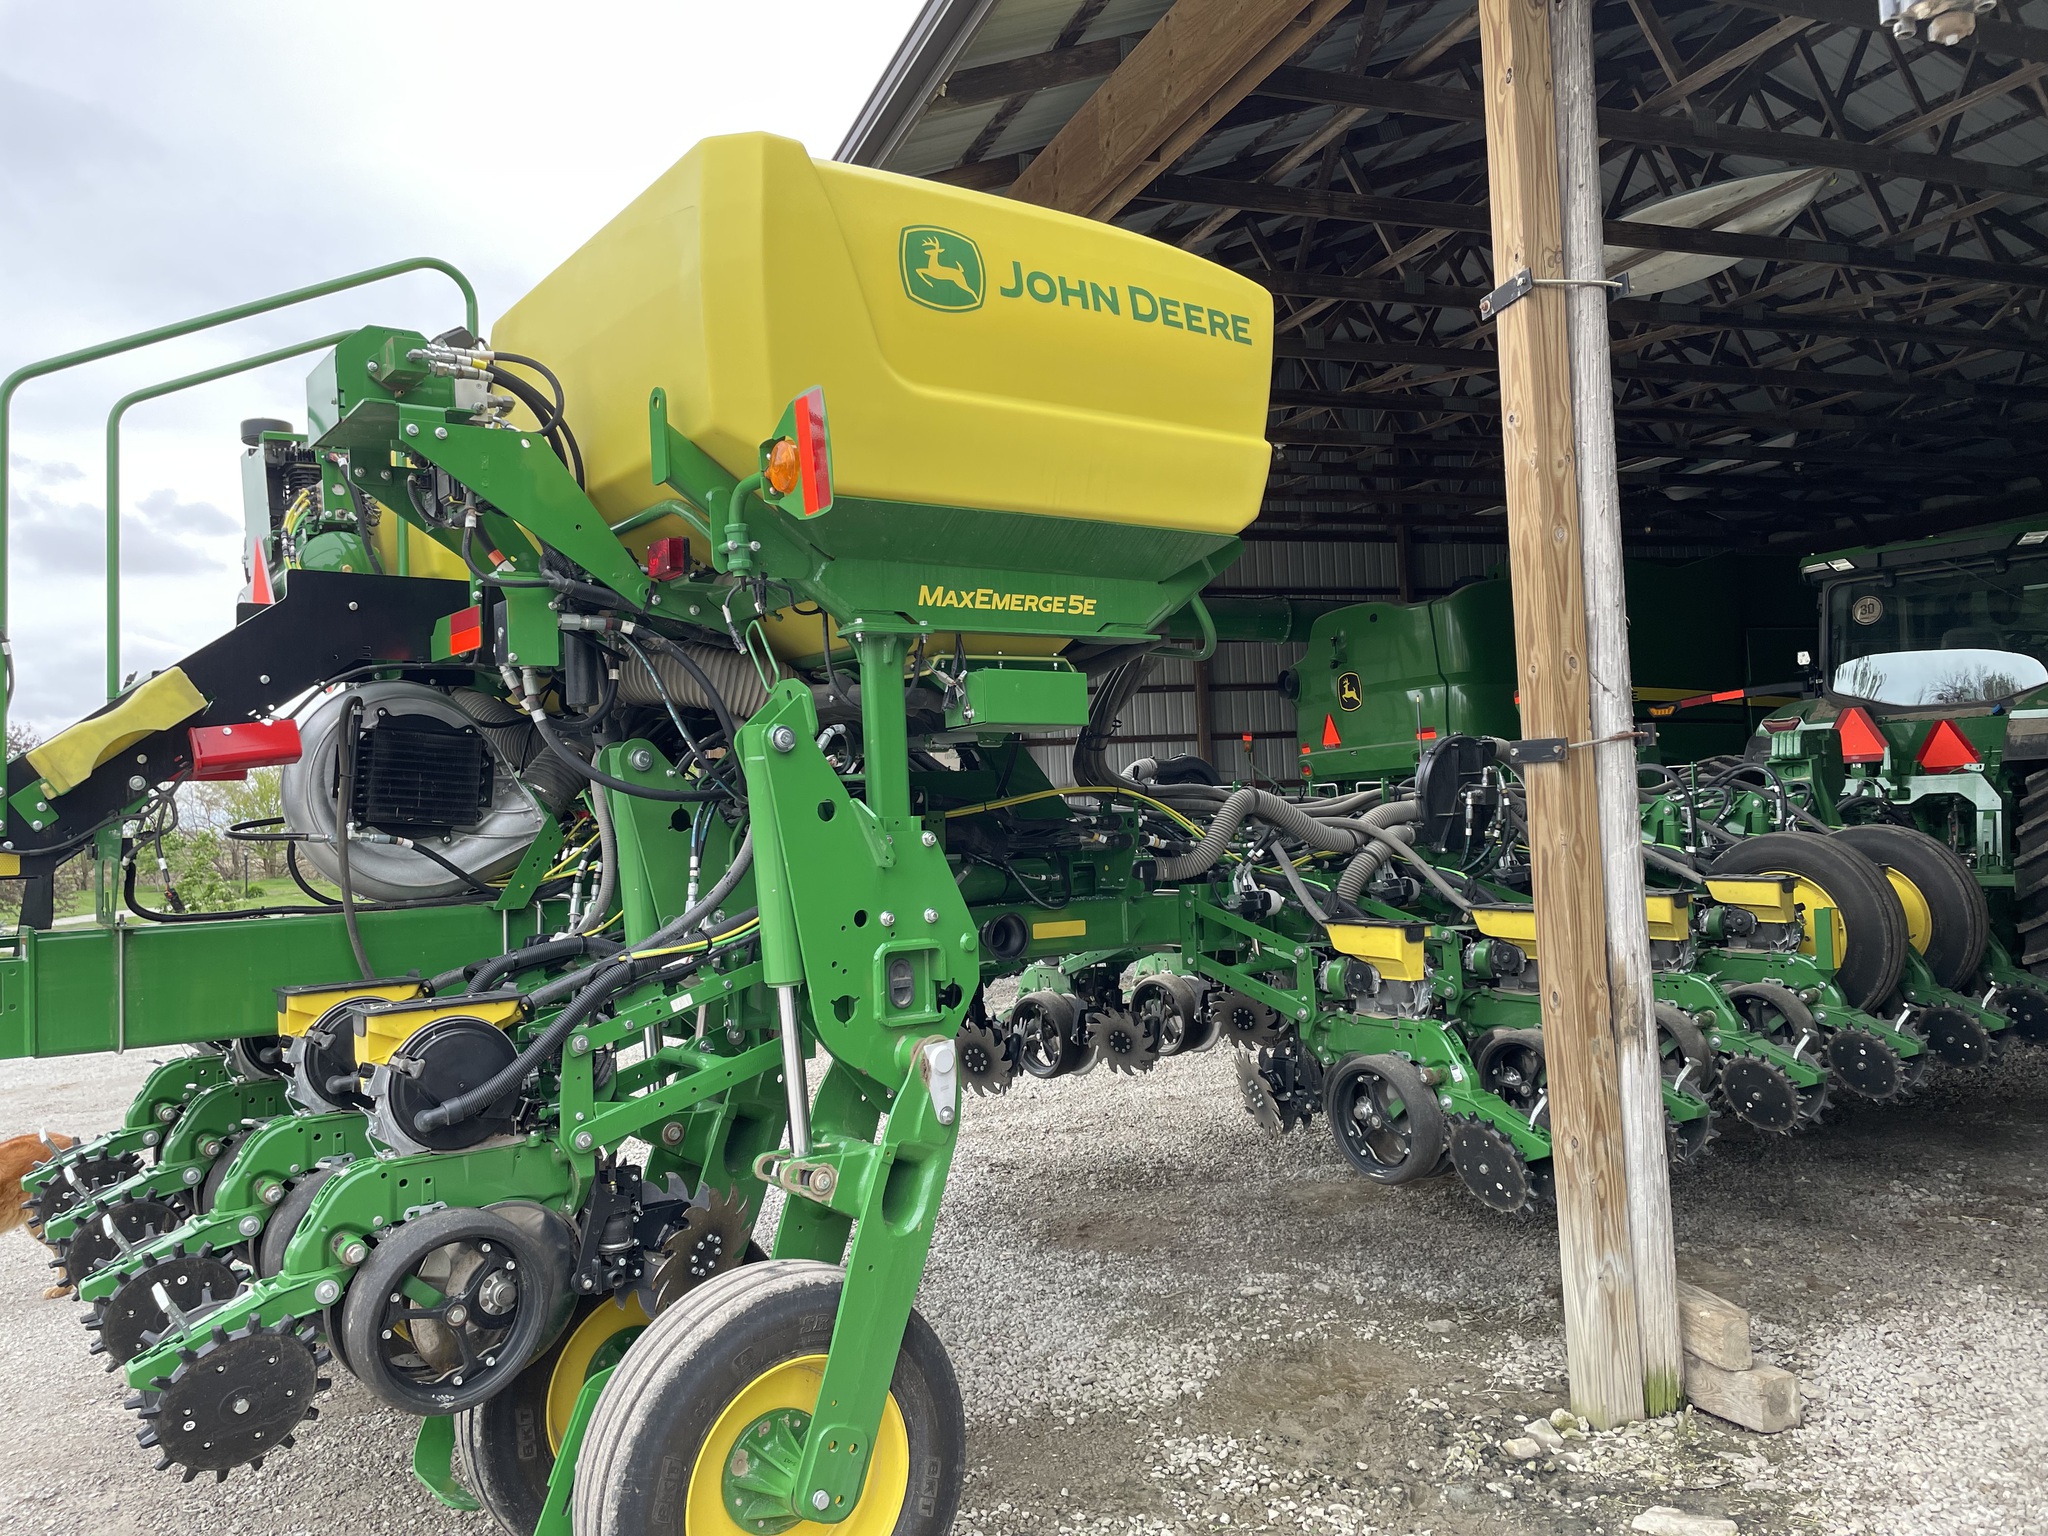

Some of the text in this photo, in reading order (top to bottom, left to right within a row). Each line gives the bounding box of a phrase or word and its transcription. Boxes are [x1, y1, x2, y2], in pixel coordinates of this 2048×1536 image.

[1000, 260, 1253, 346] JOHN DEERE
[1860, 603, 1875, 616] 30
[921, 1459, 940, 1517] BKT
